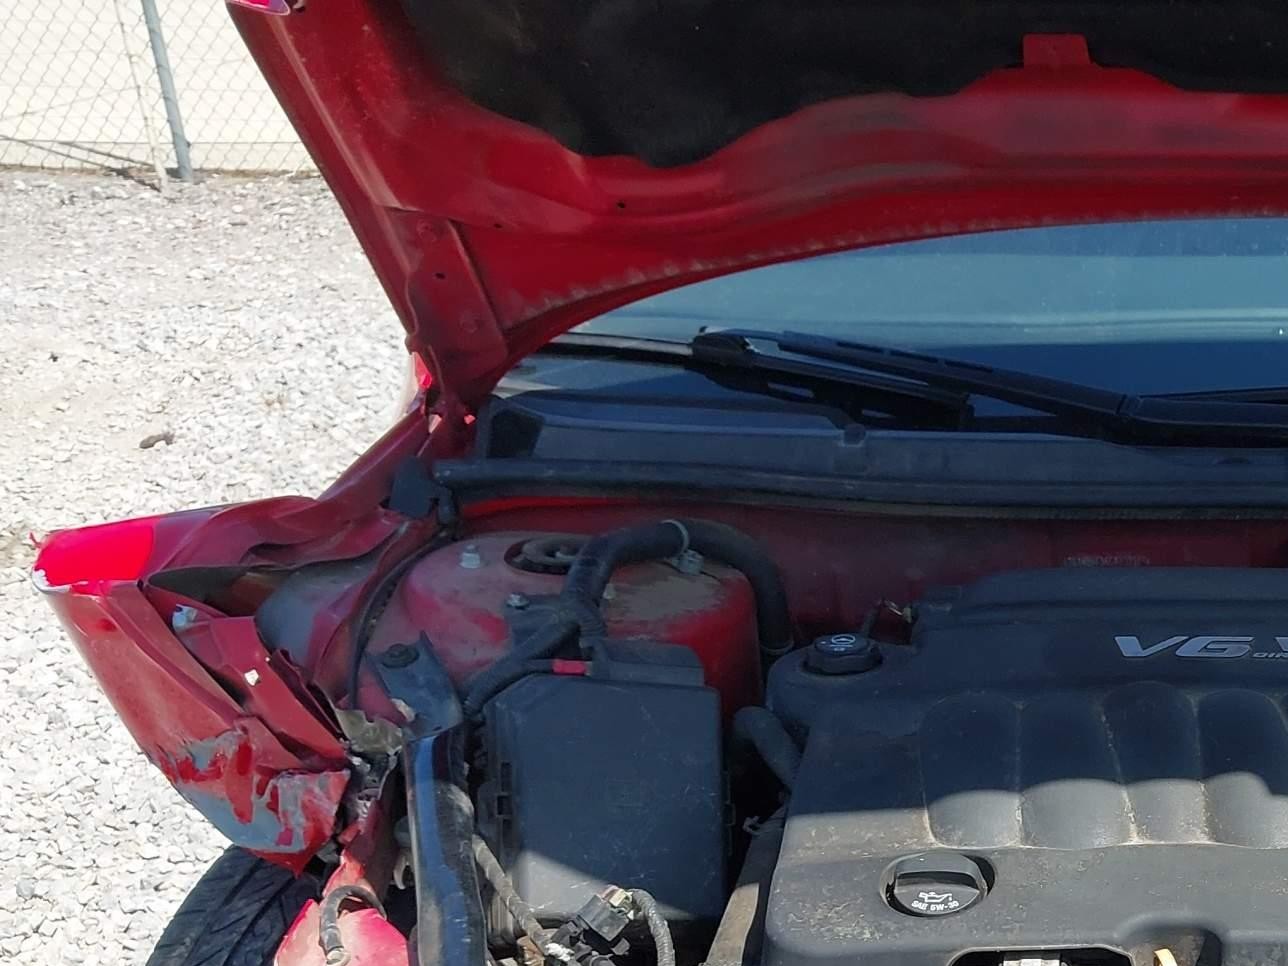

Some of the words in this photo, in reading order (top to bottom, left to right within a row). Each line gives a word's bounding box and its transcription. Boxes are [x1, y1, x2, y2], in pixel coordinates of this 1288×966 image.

[1115, 636, 1254, 658] V6
[911, 900, 929, 910] SAE
[930, 900, 960, 911] 5W-30
